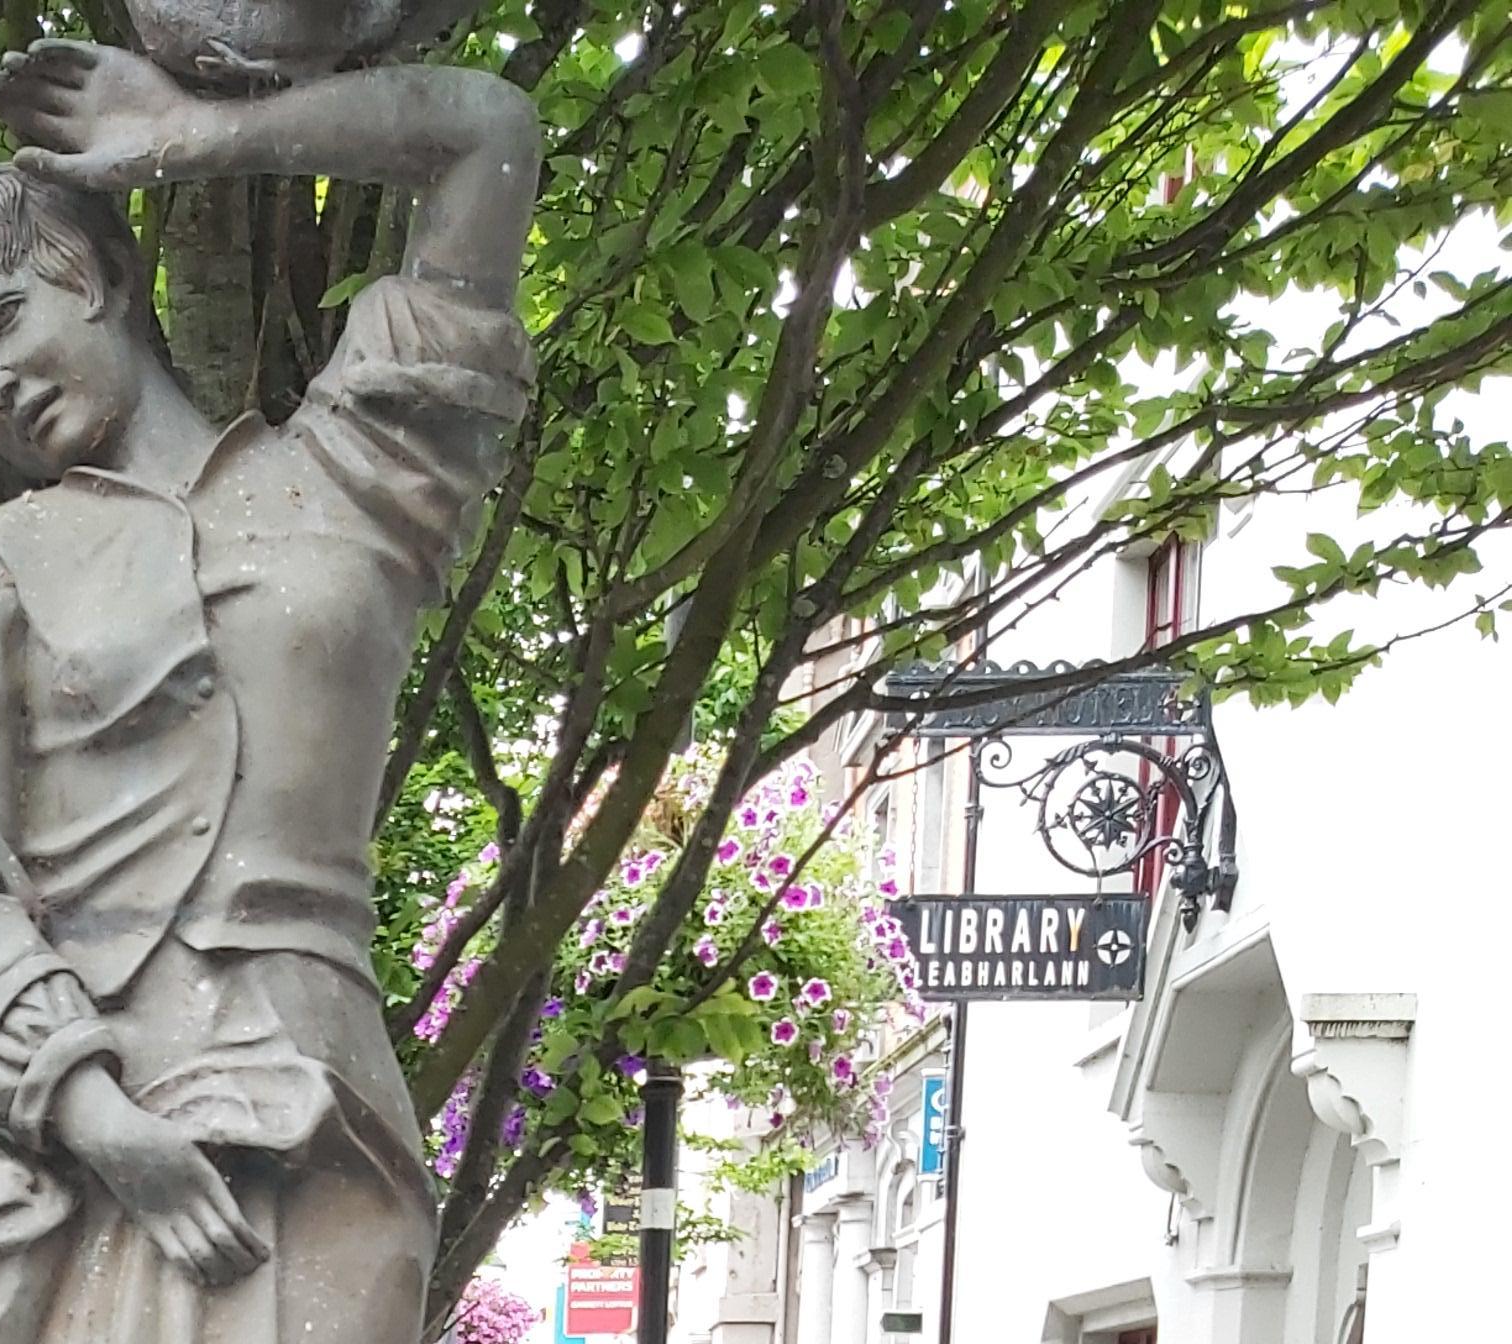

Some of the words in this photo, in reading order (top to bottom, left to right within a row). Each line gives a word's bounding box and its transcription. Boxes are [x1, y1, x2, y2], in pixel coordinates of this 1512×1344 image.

[919, 908, 1086, 954] LIBRARY
[913, 960, 1090, 987] LEABHARLANN
[571, 1280, 633, 1292] PARTNERS
